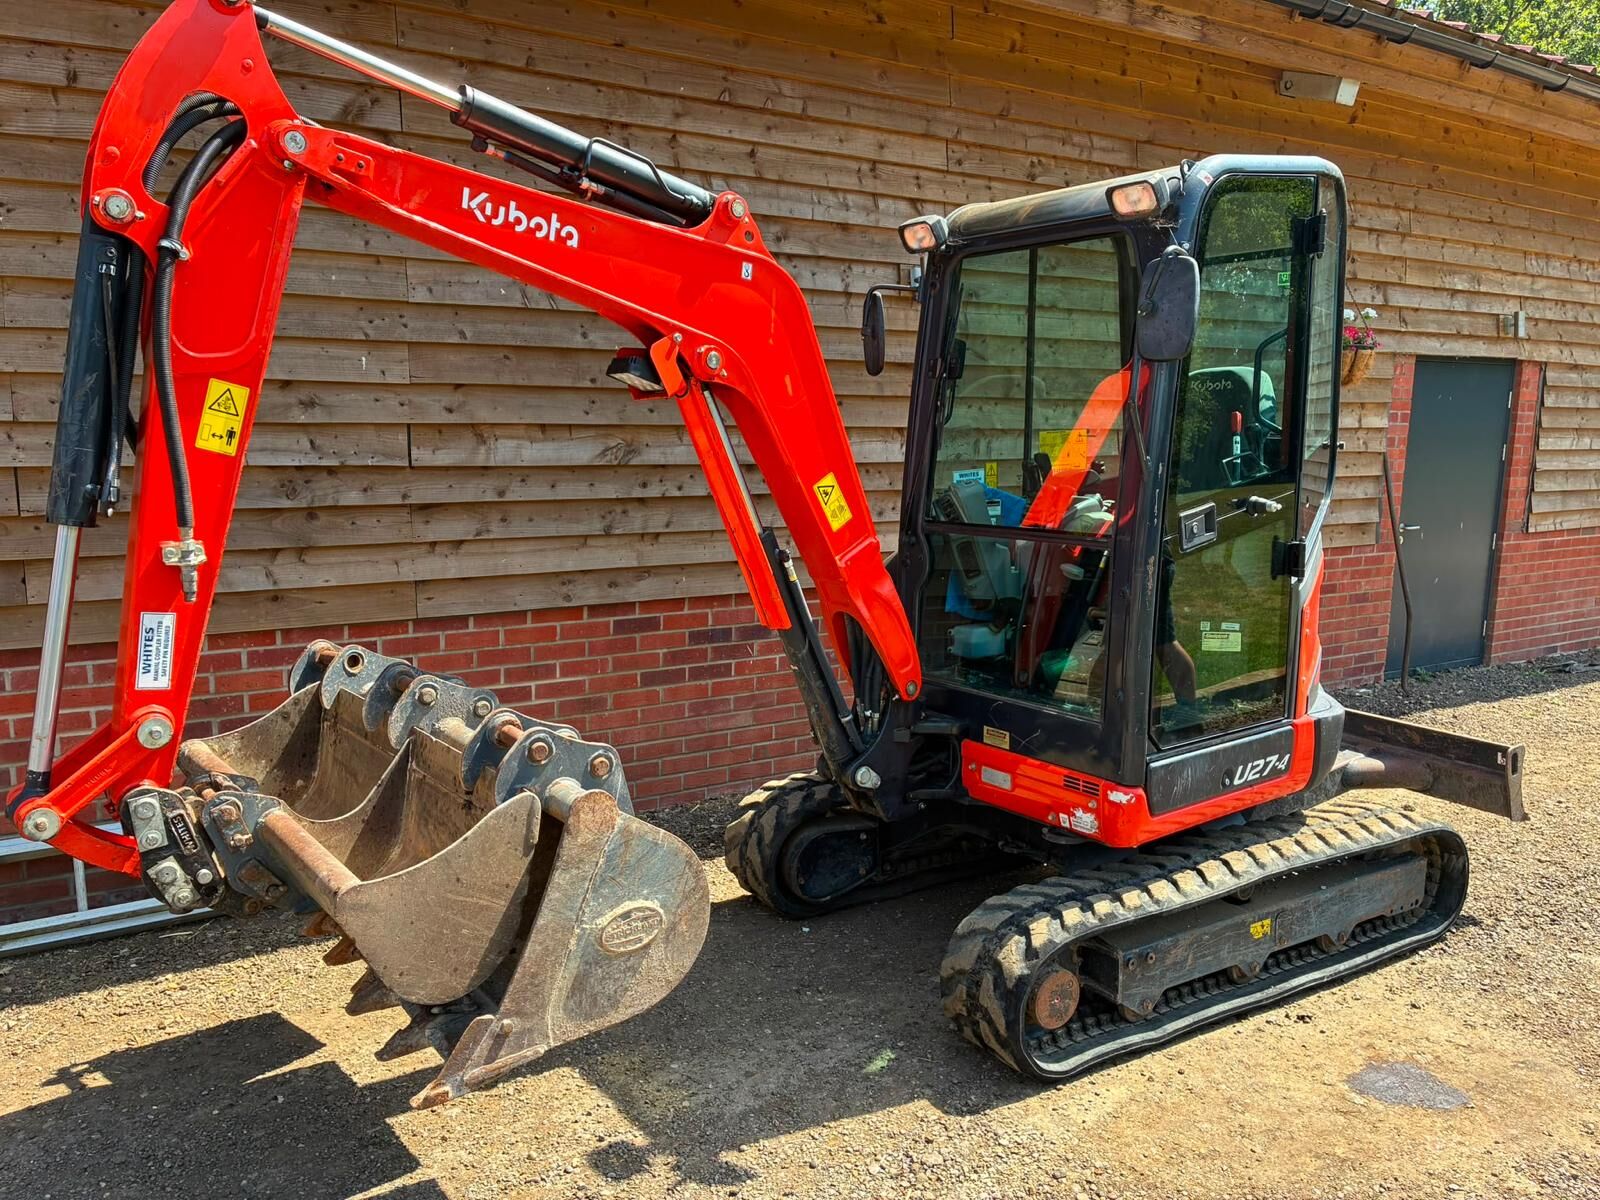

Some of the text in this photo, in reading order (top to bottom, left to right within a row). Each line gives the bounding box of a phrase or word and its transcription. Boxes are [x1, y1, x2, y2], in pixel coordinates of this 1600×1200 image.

[461, 186, 579, 249] Kubota
[1190, 379, 1232, 391] Kubota
[141, 626, 155, 675] WHITES
[154, 636, 162, 660] COUPLER
[1233, 753, 1290, 785] U27-4
[173, 815, 197, 850] WHITES
